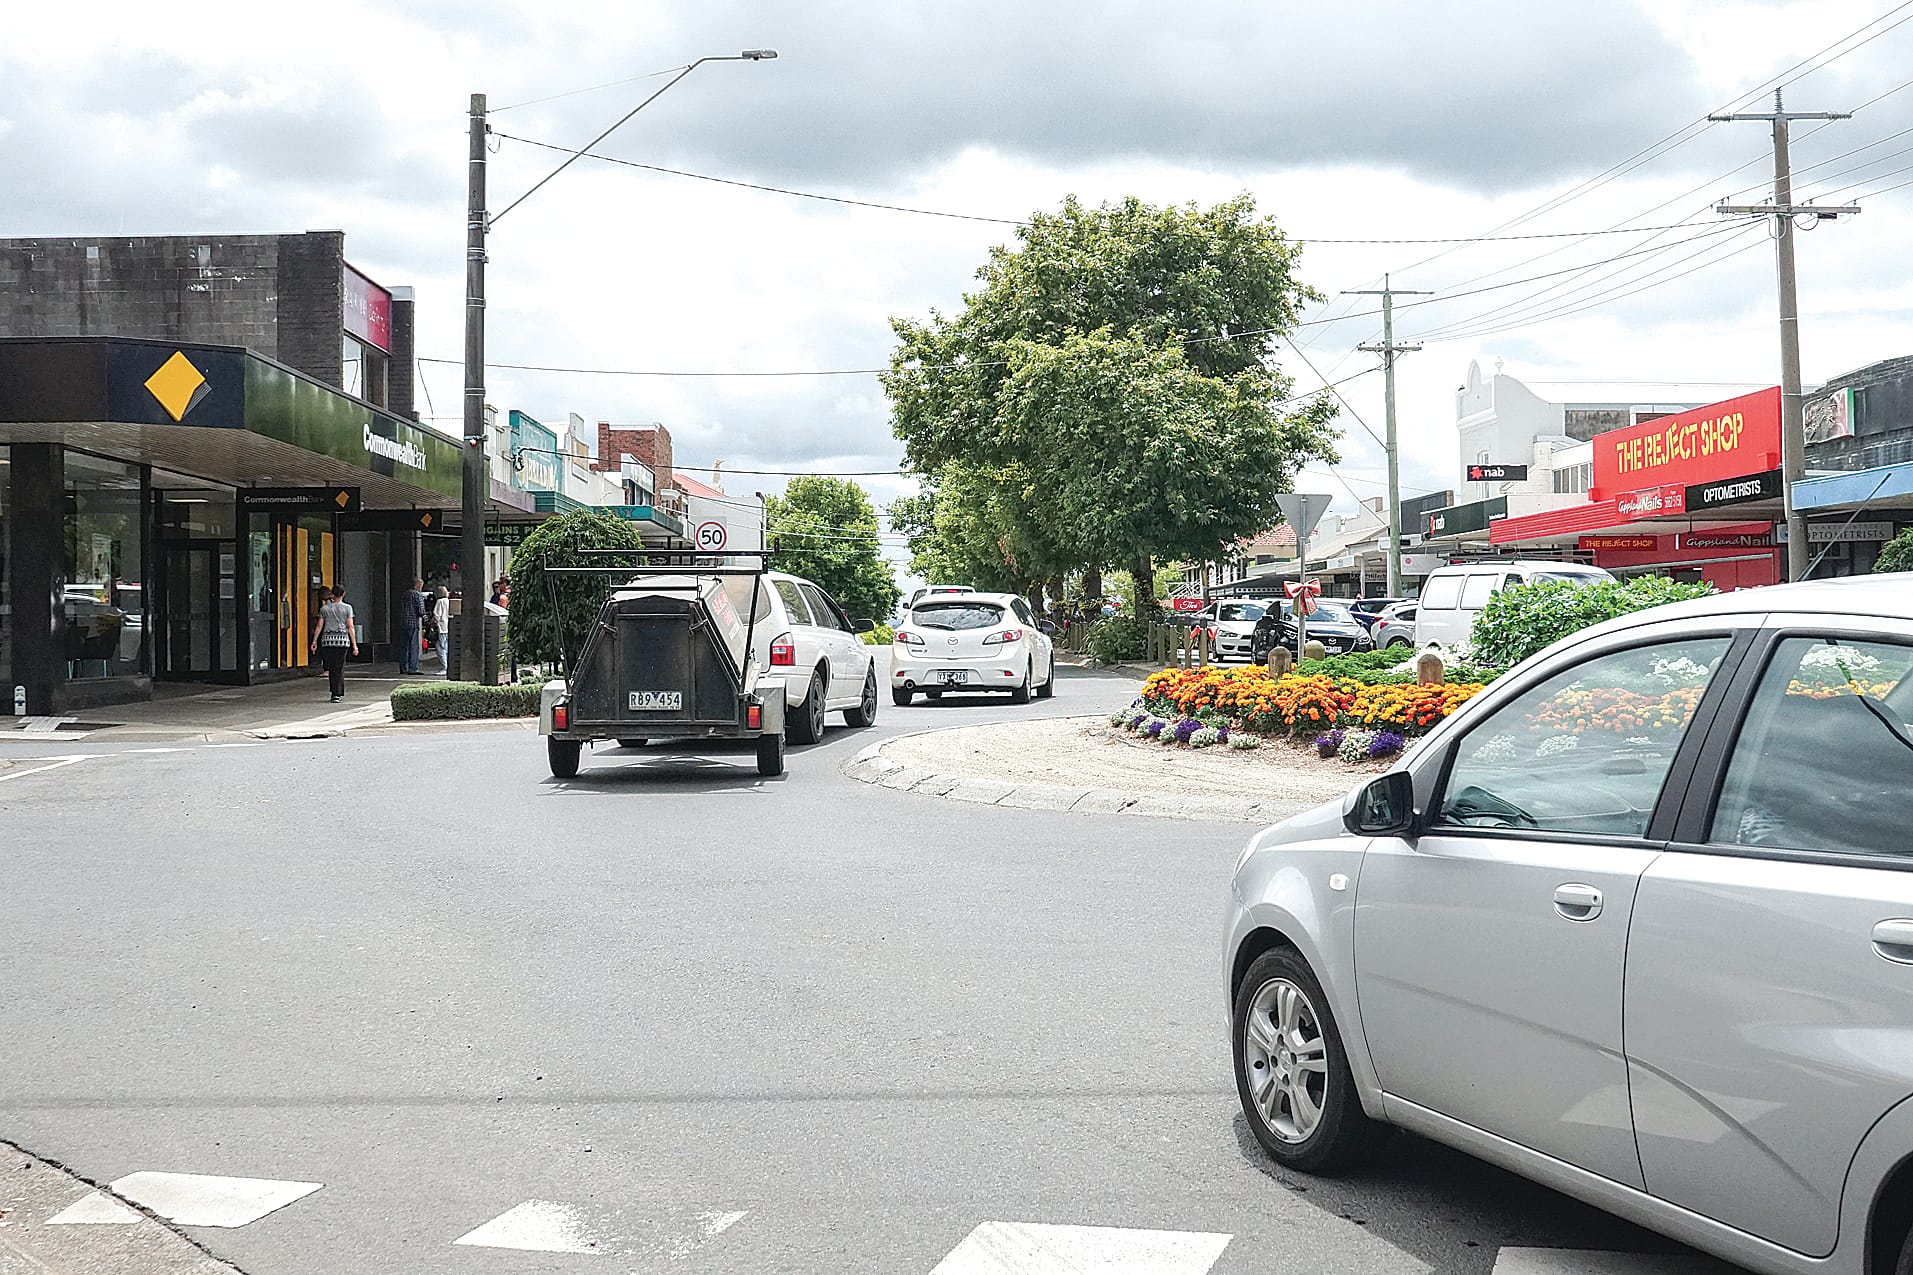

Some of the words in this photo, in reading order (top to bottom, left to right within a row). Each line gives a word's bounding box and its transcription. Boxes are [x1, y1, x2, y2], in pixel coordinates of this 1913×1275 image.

[1616, 437, 1642, 474] THE
[1644, 421, 1698, 469] REJECT
[1700, 412, 1744, 457] SHOP
[1484, 466, 1505, 478] nab
[1703, 479, 1761, 503] OPTOMETRISTS
[1641, 495, 1663, 511] Nails
[701, 529, 723, 545] 50
[1585, 540, 1601, 548] THE
[1602, 538, 1631, 548] REJECT
[1632, 539, 1654, 547] SHOP
[631, 694, 651, 706] R89
[659, 694, 681, 706] 454
